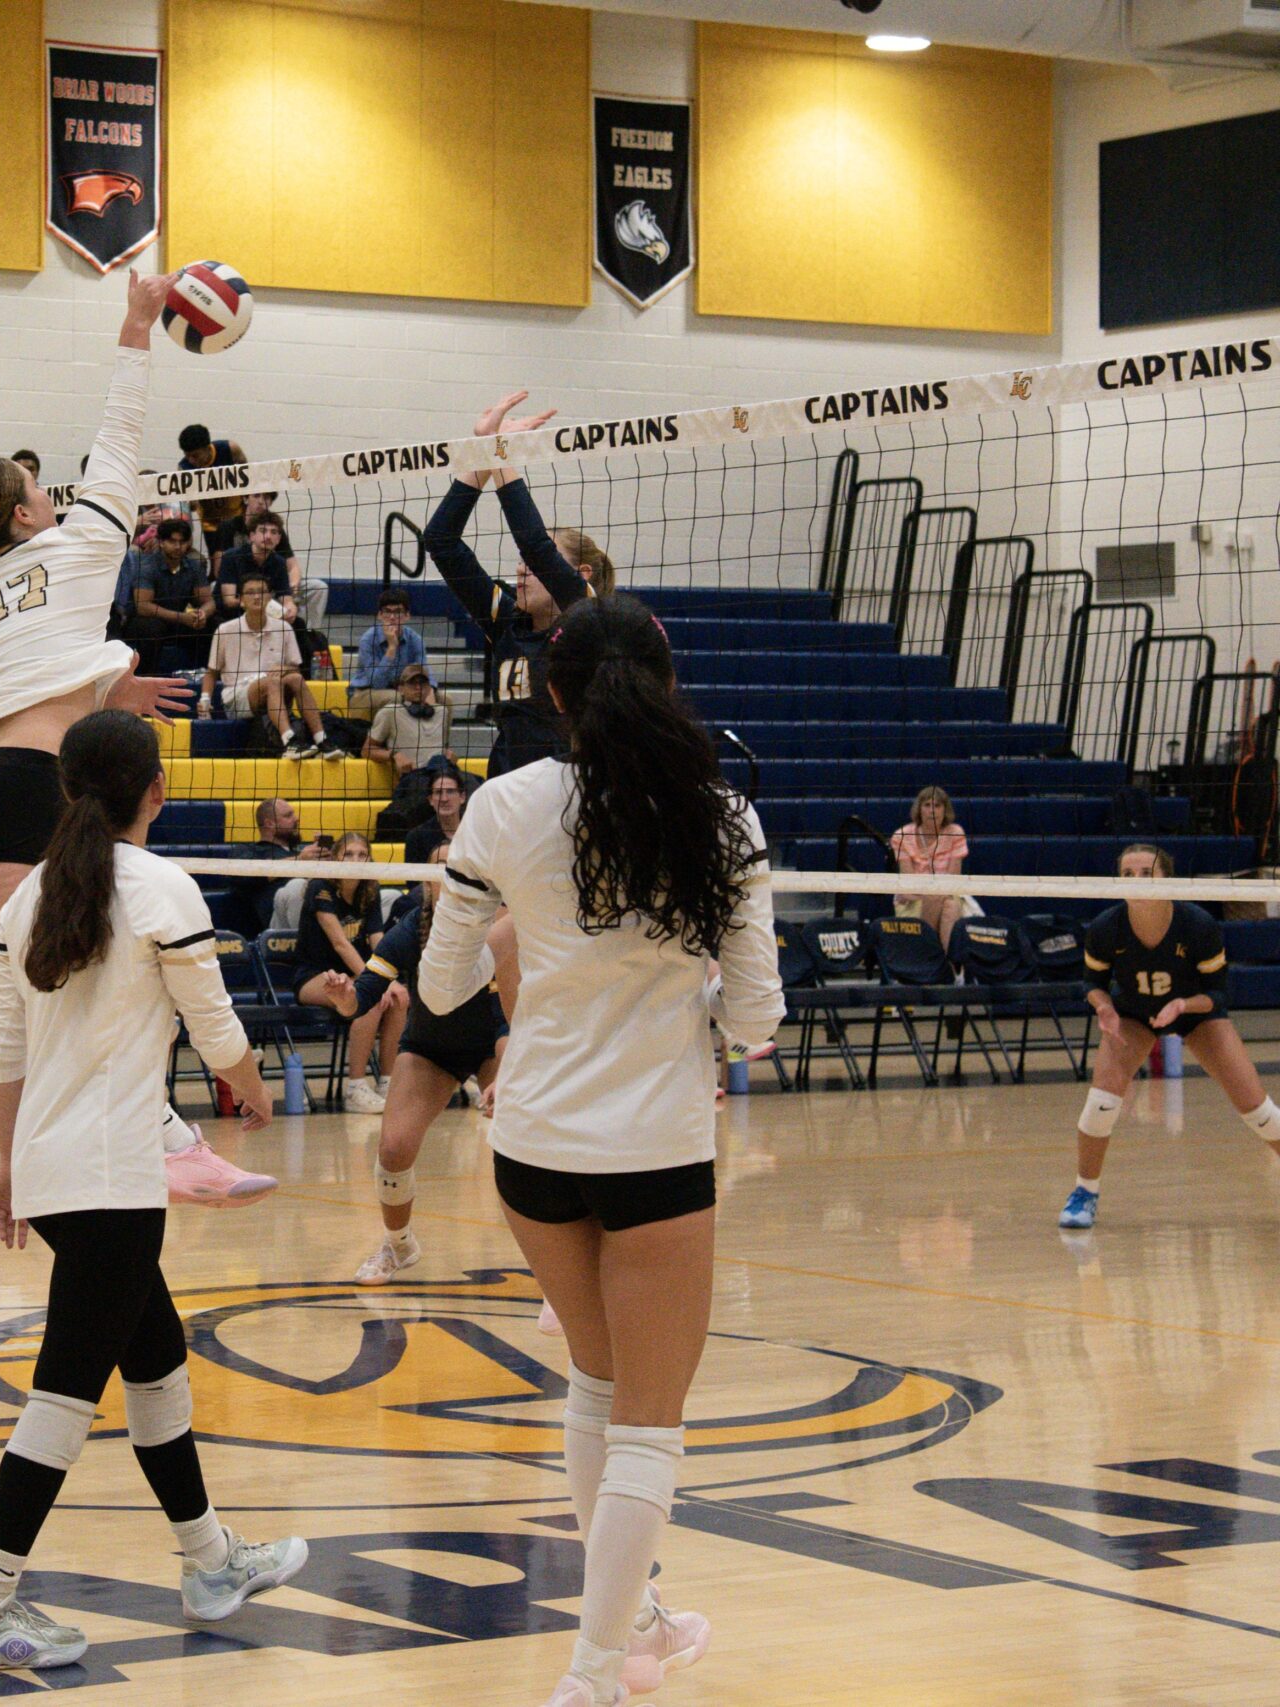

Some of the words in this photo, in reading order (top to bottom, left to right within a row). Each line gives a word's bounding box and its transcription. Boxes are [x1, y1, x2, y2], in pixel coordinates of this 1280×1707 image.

[53, 76, 99, 102] BRIAR
[104, 81, 155, 106] WOODS
[64, 118, 143, 148] FALCONS
[610, 126, 674, 152] FREEDOM
[613, 164, 672, 190] EAGLES
[157, 465, 249, 496] CAPTAINS
[342, 442, 449, 477] CAPTAINS
[554, 414, 678, 453] CAPTAINS
[805, 380, 949, 425] CAPTAINS
[1097, 339, 1272, 390] CAPTAINS
[267, 938, 298, 952] CAPT
[1136, 971, 1172, 996] 12
